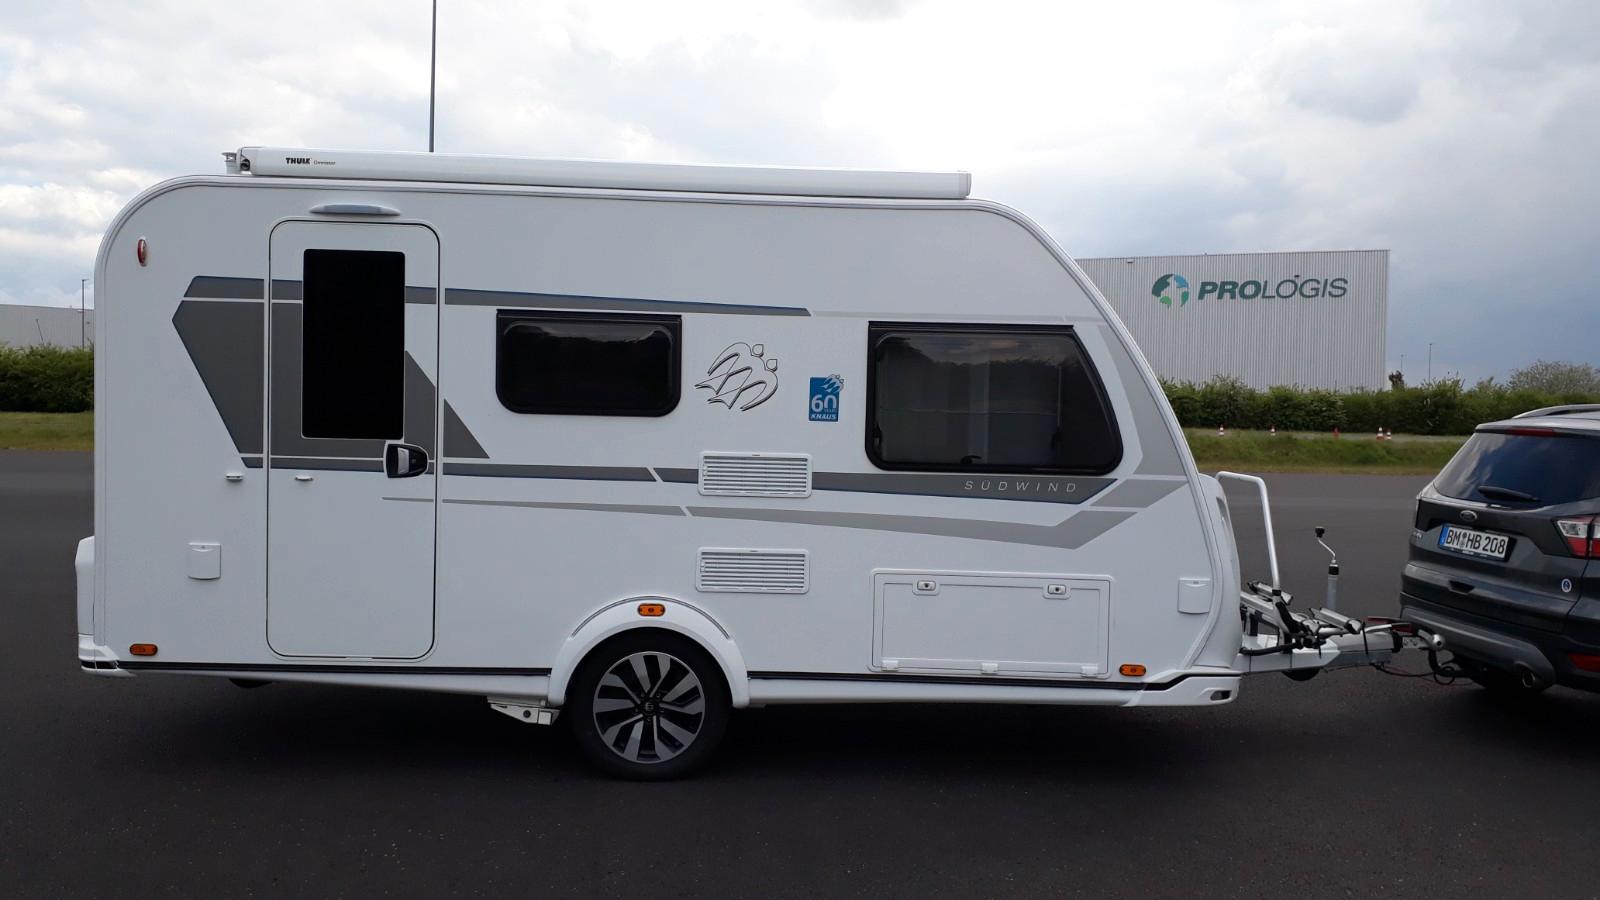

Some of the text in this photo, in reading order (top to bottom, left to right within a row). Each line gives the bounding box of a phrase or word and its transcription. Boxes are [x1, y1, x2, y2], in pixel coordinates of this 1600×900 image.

[285, 157, 311, 165] THULE
[1198, 278, 1349, 300] PROLOGIS
[811, 394, 837, 412] 60
[1446, 529, 1461, 546] BM
[1465, 532, 1482, 550] HB
[1482, 536, 1507, 555] 208
